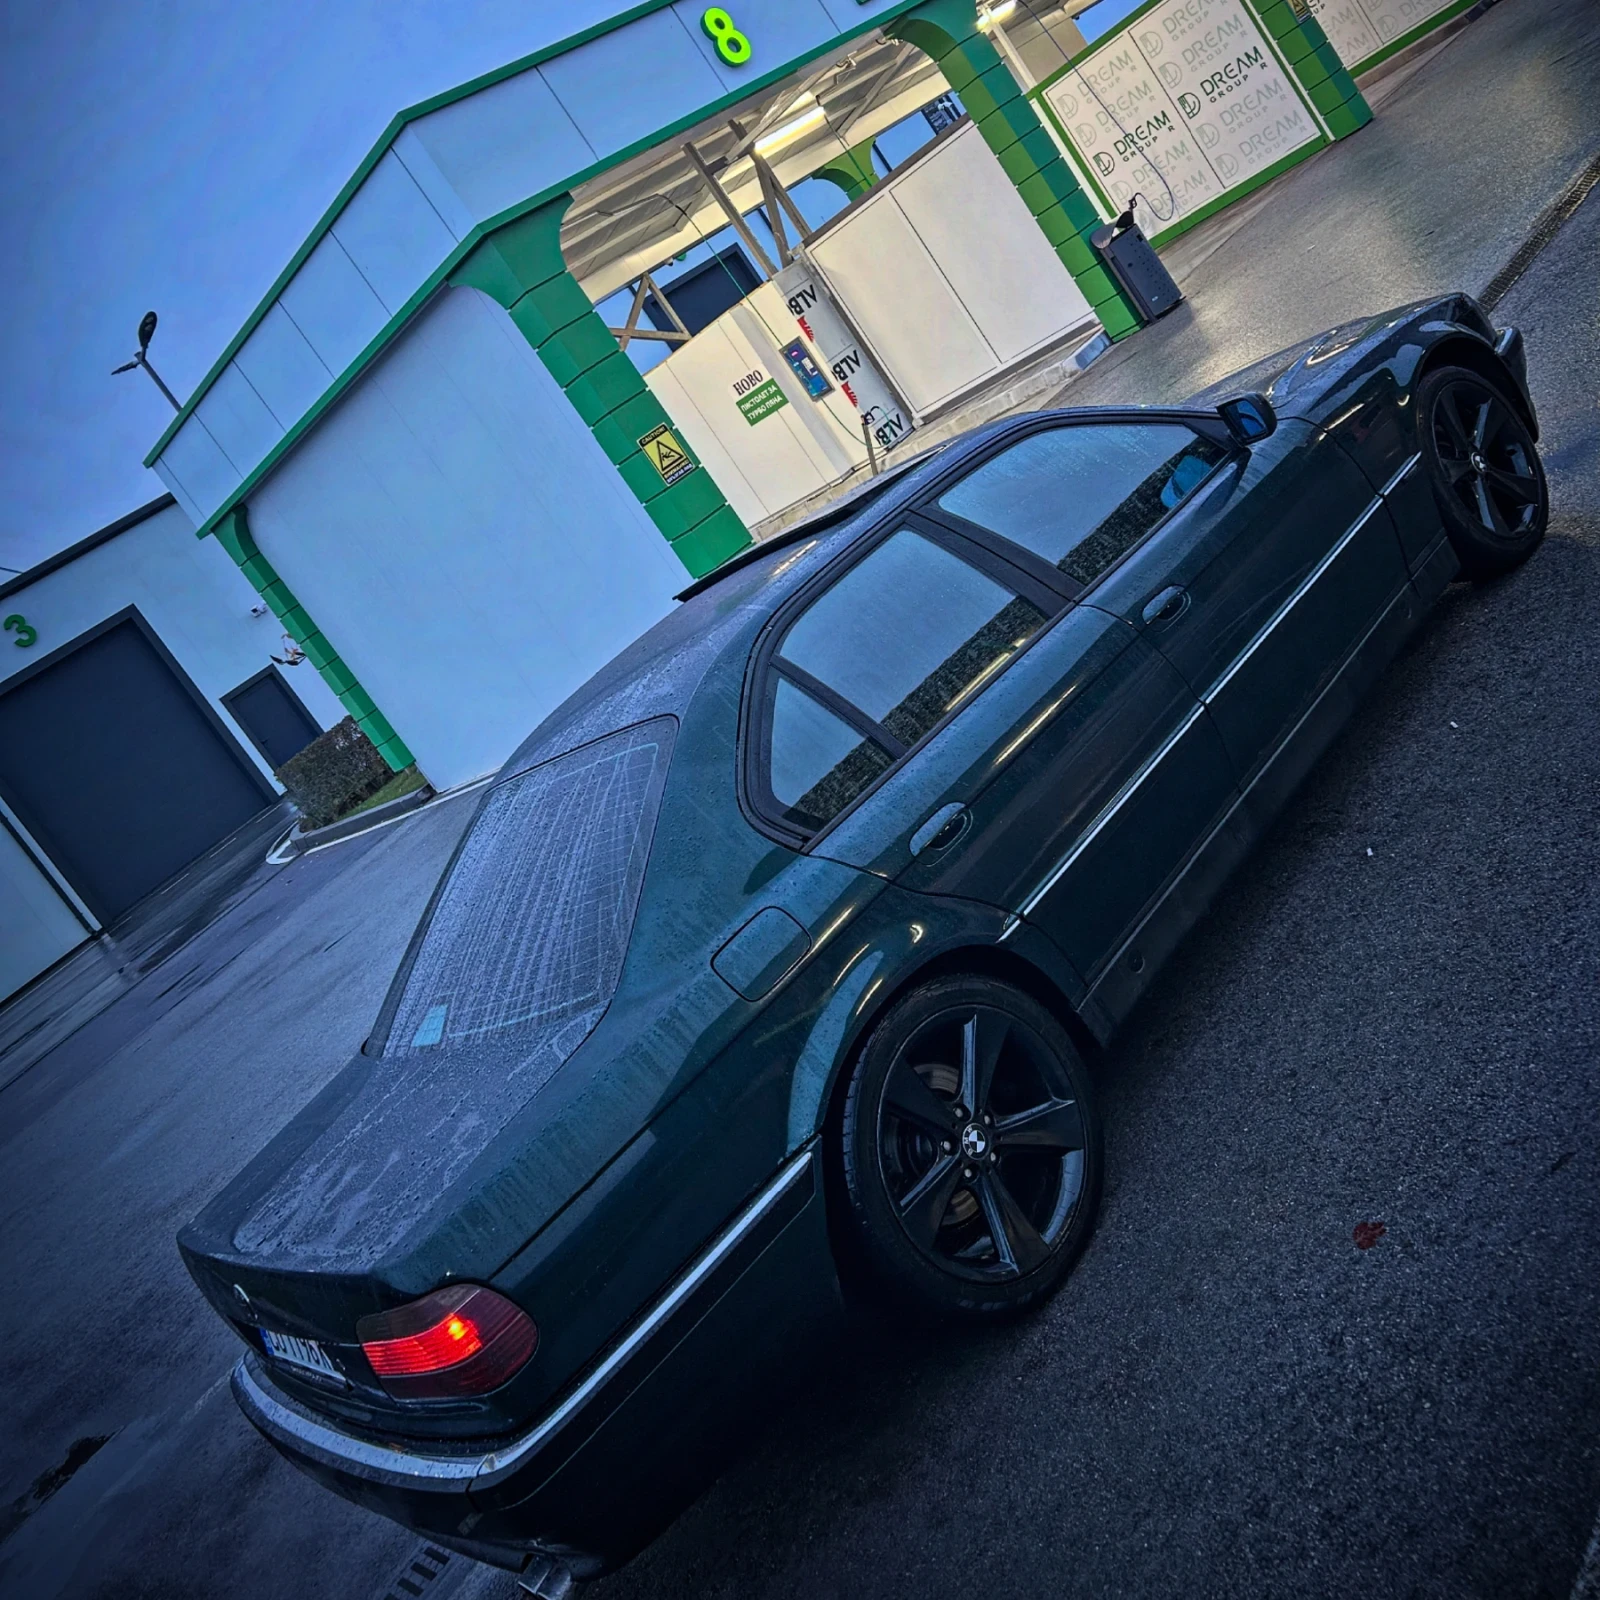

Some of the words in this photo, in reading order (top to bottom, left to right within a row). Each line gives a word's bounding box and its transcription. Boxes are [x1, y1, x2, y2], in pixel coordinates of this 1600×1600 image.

[701, 7, 751, 67] 8
[1181, 13, 1244, 65] DREAM
[1190, 42, 1229, 73] GROUP
[1077, 49, 1134, 97] DREAM
[1200, 45, 1264, 97] DREAM
[1209, 74, 1249, 104] GROUP
[1095, 80, 1152, 127] DREAM
[1219, 78, 1284, 127] DREAM
[1228, 105, 1269, 134] GROUP
[1113, 110, 1172, 156] DREAM
[1122, 135, 1159, 162] GROUP
[1238, 110, 1304, 157] DREAM
[1131, 140, 1190, 185] DREAM
[1150, 169, 1208, 214] DREAM
[732, 369, 764, 397] НОВО
[740, 389, 769, 413] ПИСТОЛЕТ
[767, 384, 778, 395] ЗА
[747, 404, 767, 420] ТУРБО
[3, 614, 38, 649] 3
